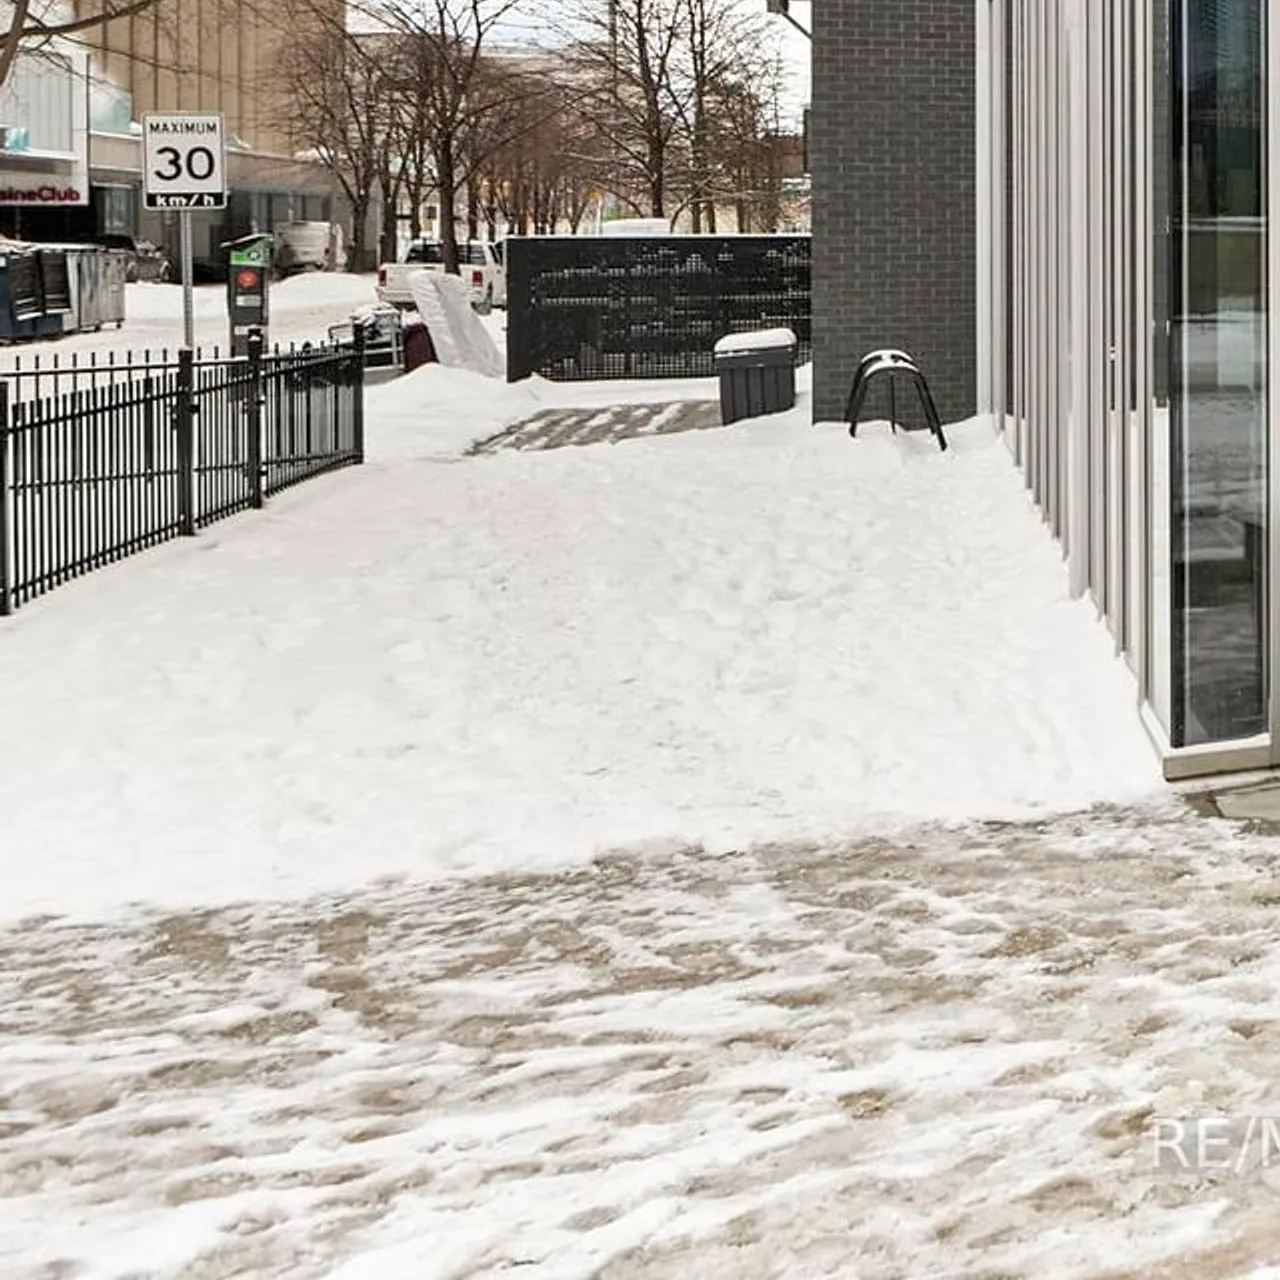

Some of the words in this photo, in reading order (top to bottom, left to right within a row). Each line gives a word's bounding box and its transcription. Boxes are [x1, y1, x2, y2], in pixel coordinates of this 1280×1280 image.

[149, 122, 217, 134] MAXIMUM
[154, 146, 215, 180] 30
[156, 194, 214, 207] km/h
